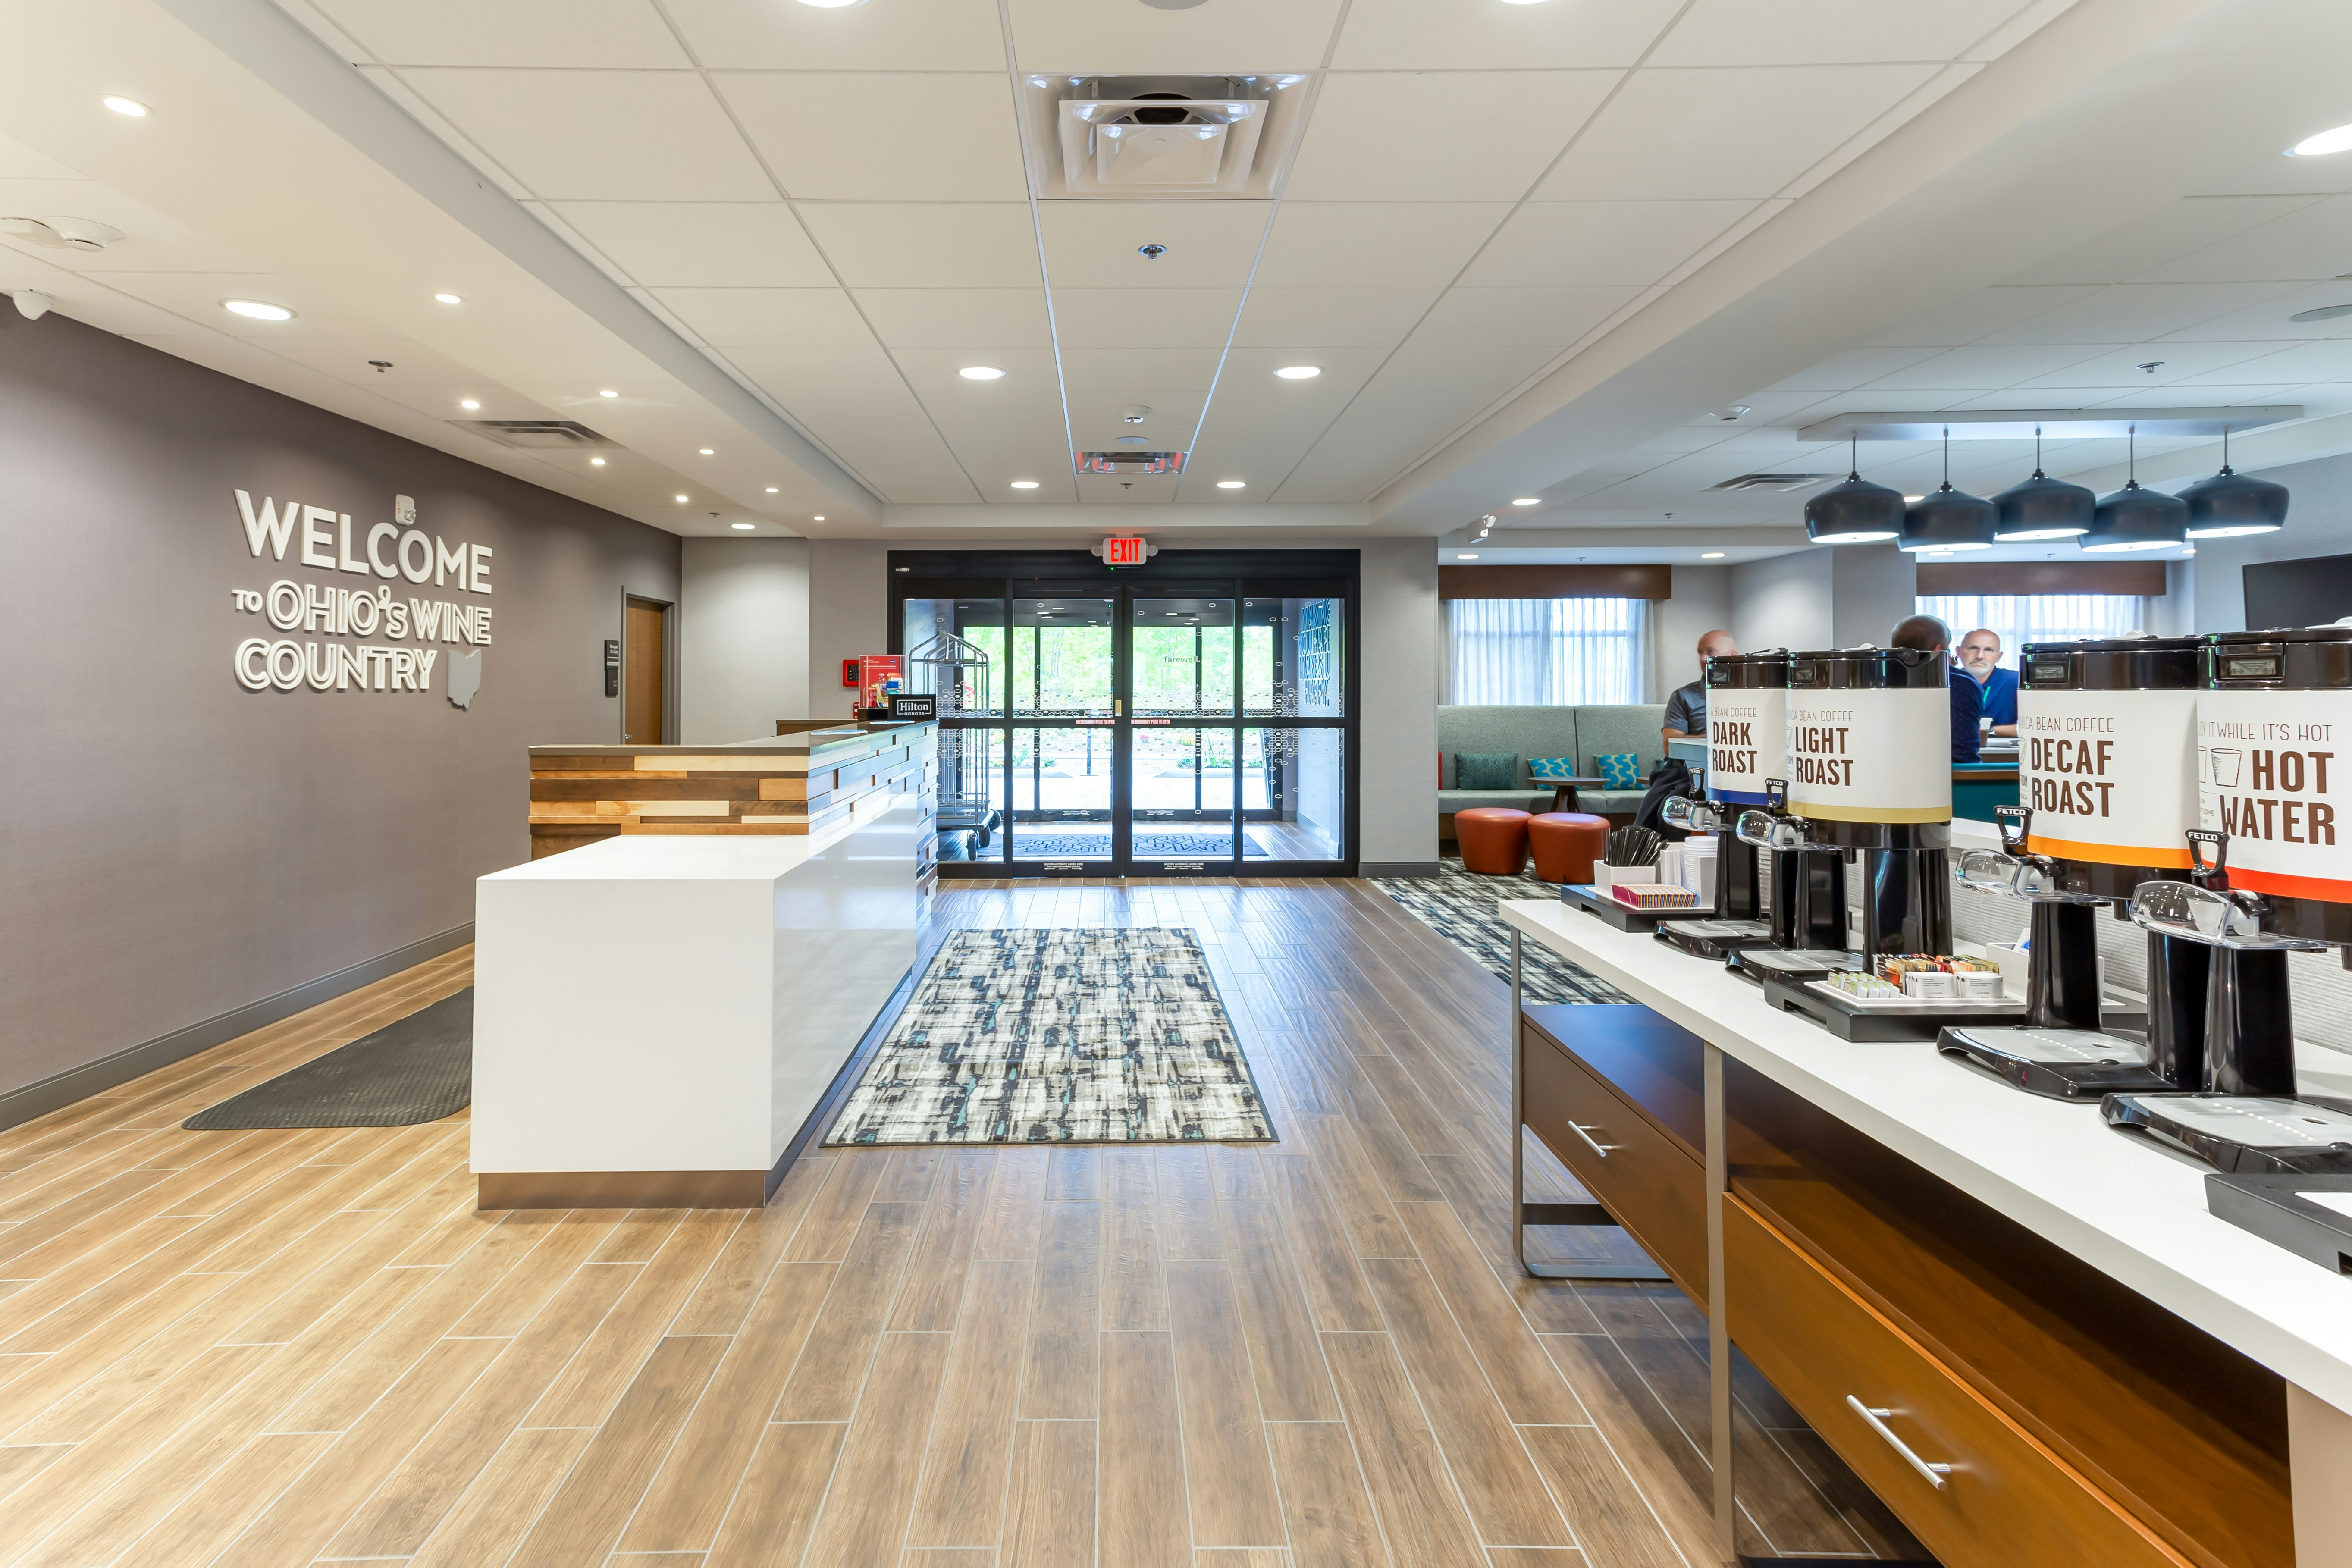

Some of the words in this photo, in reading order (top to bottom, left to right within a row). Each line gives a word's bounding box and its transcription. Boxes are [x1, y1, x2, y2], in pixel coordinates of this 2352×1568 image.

[234, 489, 492, 594] WELCOME
[1110, 539, 1141, 562] EXIT
[232, 589, 263, 612] TO
[408, 598, 492, 645] WINE
[235, 638, 438, 690] COUNTRY
[900, 702, 928, 711] Hilton
[1715, 707, 1728, 717] BEAN
[1731, 708, 1757, 717] COFFEE
[1800, 710, 1817, 721] BEAN
[1821, 711, 1853, 722] COFFEE
[1713, 721, 1752, 746] DARK
[2036, 717, 2060, 731] BEAN
[2067, 718, 2114, 732] COFFEE
[2209, 722, 2214, 737] IT
[2217, 722, 2255, 740] WHILE
[2263, 724, 2289, 740] IT'S
[2299, 724, 2332, 742] HOT
[1796, 726, 1849, 754] LIGHT
[1712, 749, 1757, 774] ROAST
[2031, 737, 2114, 775] DECAF
[1796, 757, 1853, 786] ROAST
[2252, 750, 2334, 794] HOT
[2032, 777, 2114, 817] ROAST
[2220, 795, 2335, 845] WATER
[2188, 831, 2218, 841] FETCO
